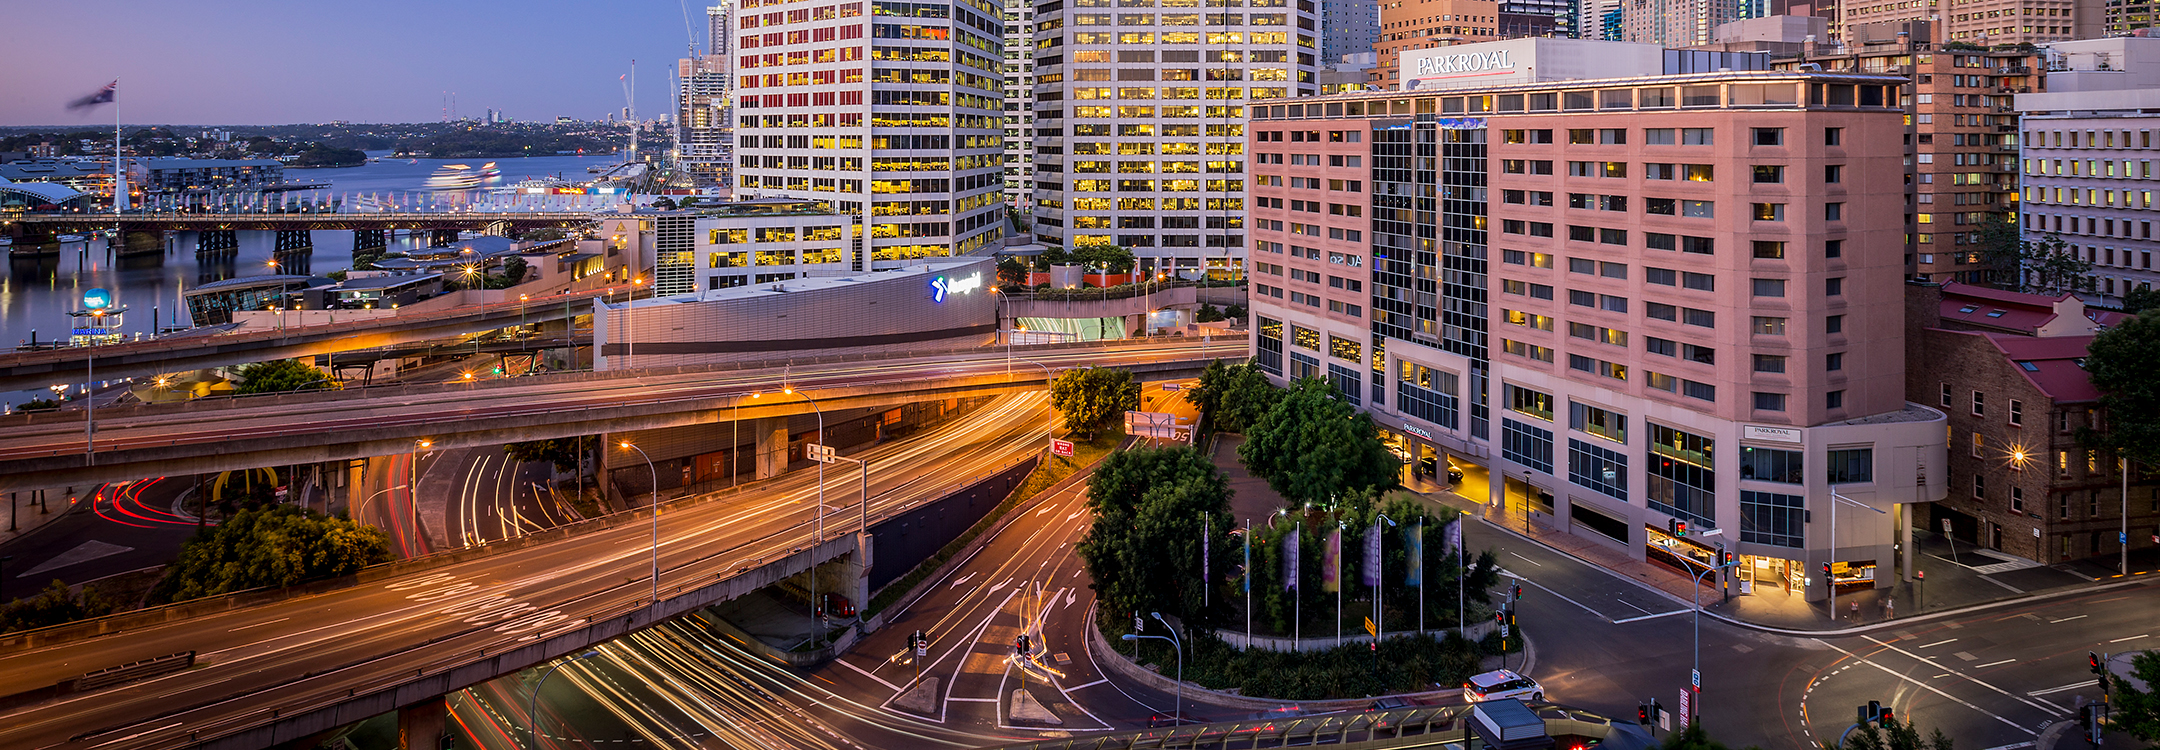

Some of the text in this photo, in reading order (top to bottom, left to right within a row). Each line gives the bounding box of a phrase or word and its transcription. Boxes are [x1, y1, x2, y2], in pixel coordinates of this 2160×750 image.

[1417, 50, 1515, 75] PARKROYAL
[1404, 423, 1433, 438] PARKROYAL
[1754, 427, 1790, 435] PARKROYAL
